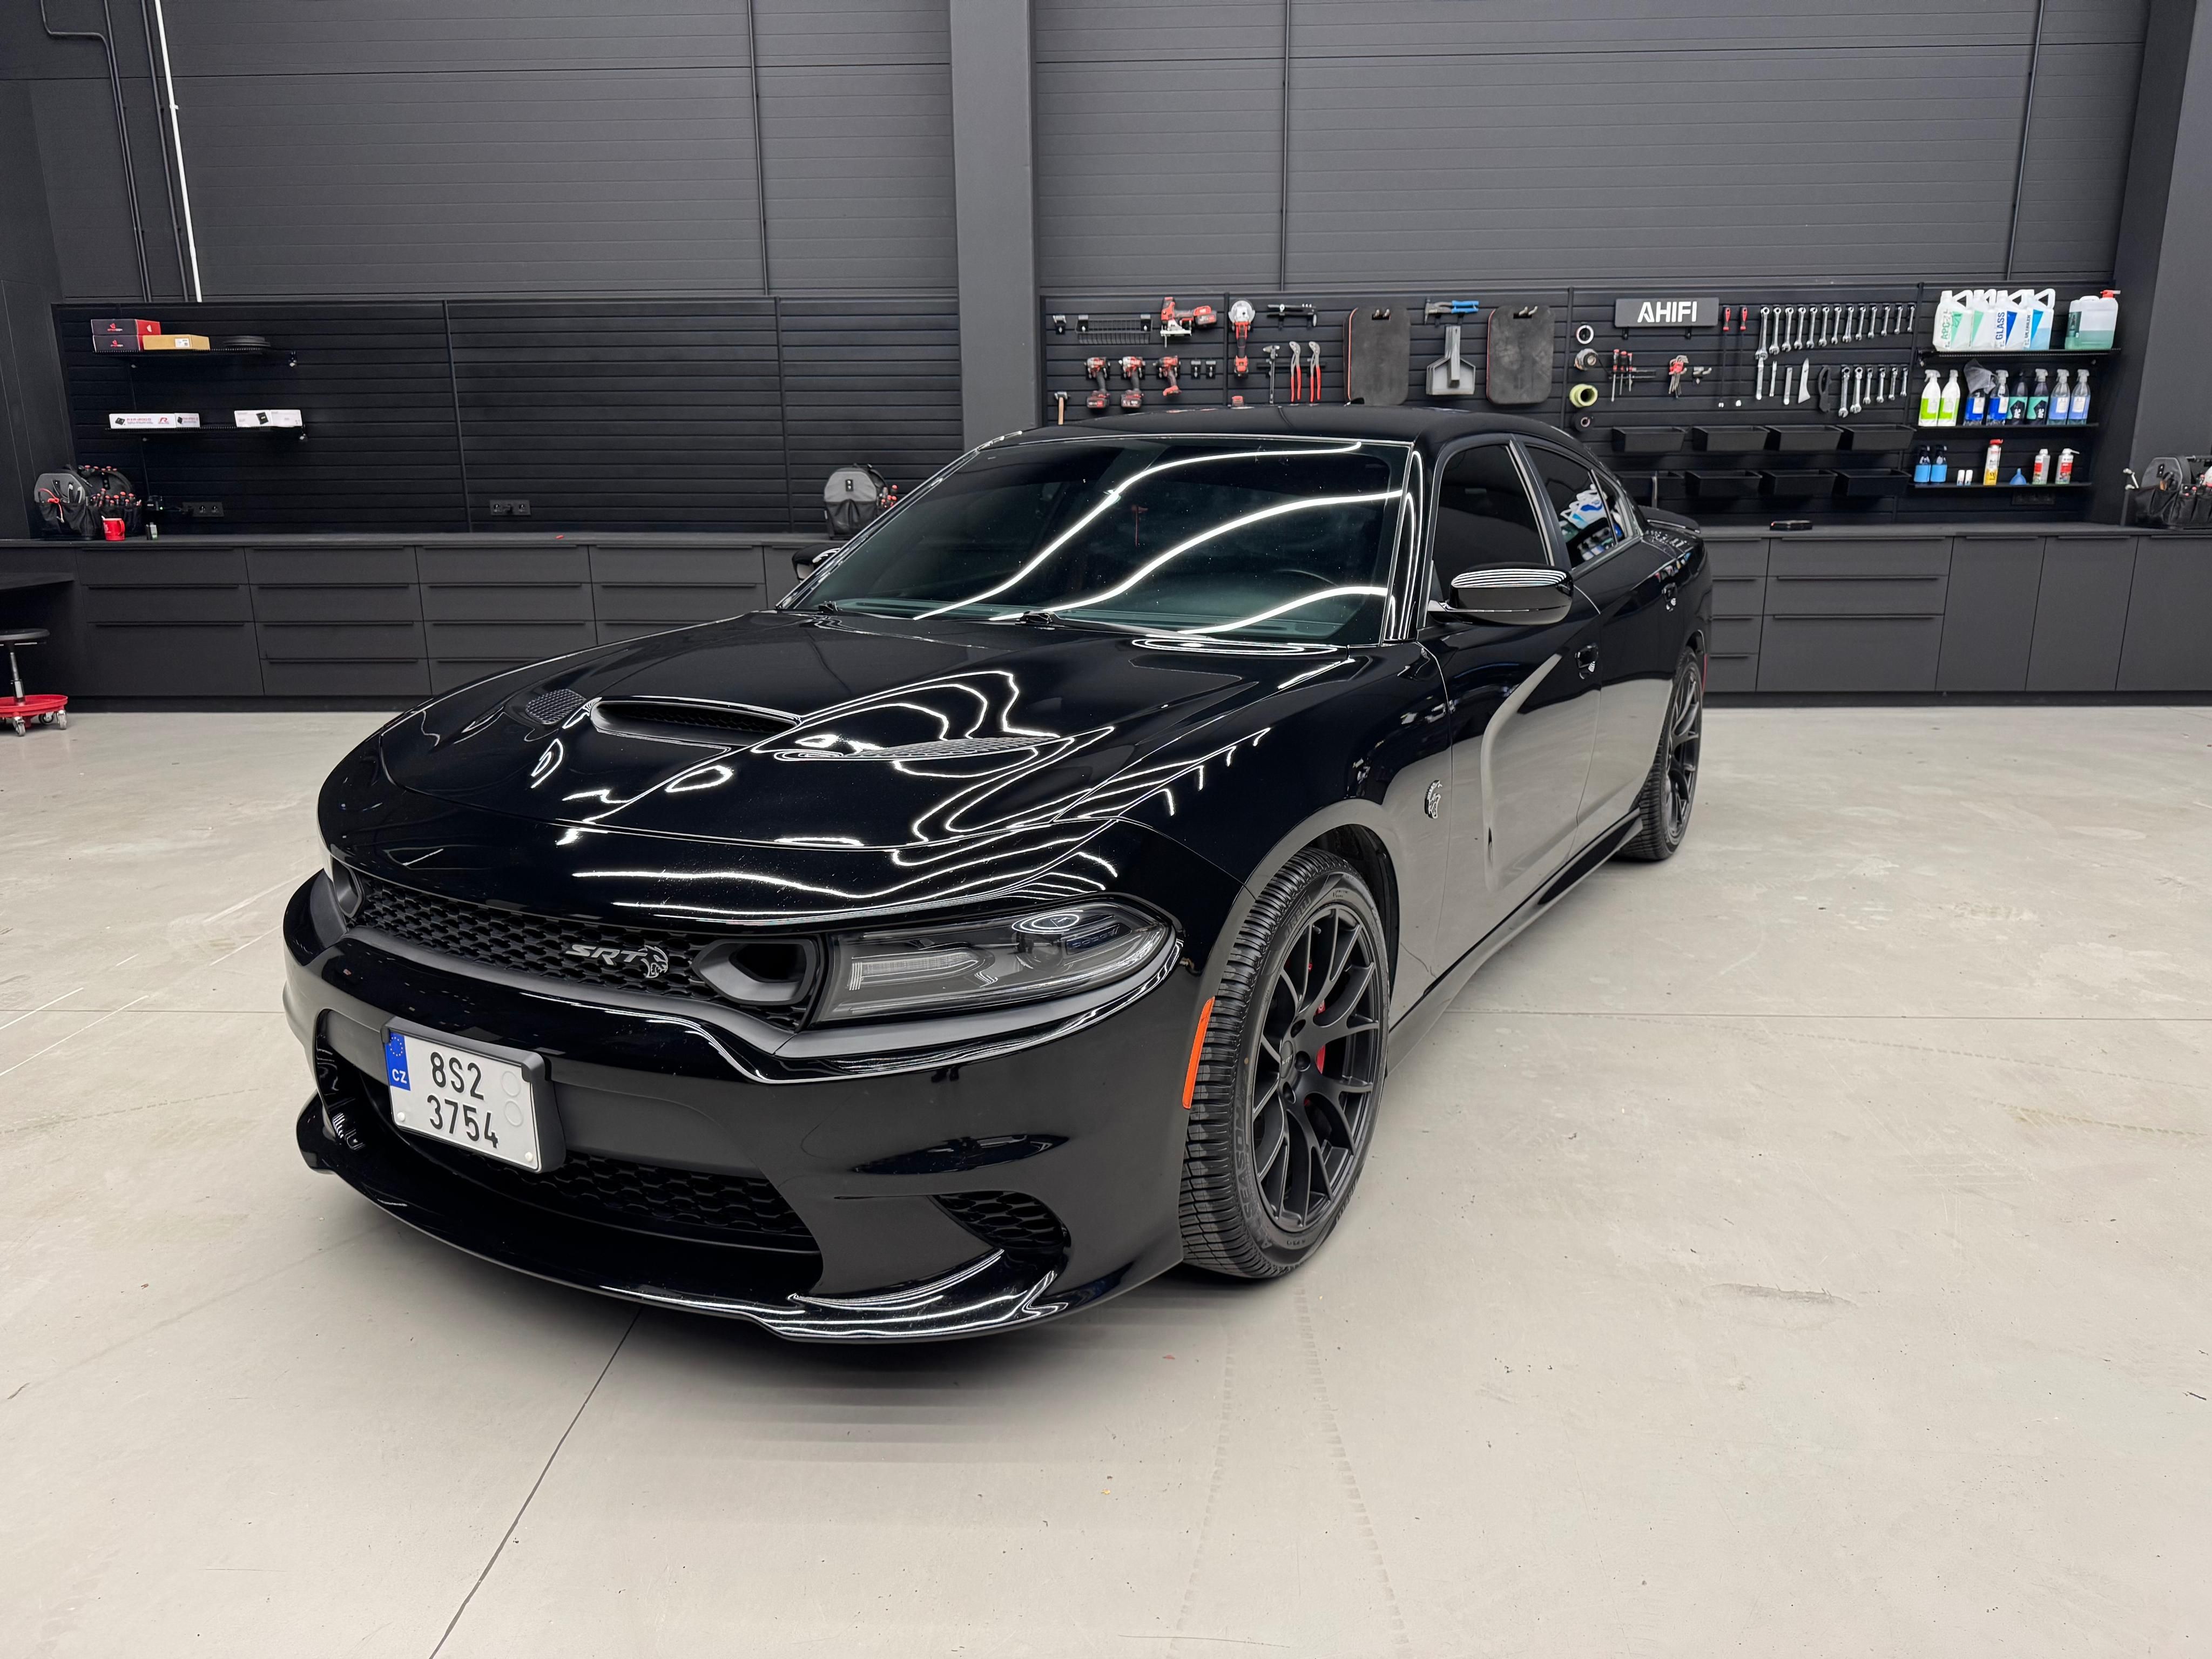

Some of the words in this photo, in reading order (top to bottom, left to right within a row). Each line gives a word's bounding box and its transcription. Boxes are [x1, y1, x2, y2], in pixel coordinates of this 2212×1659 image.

[1637, 301, 1697, 323] AHIFI
[1995, 312, 2005, 340] GLASS
[565, 944, 648, 966] SRT
[392, 1068, 407, 1083] CZ
[430, 1051, 484, 1101] 8S2
[427, 1094, 498, 1149] 3754
[1235, 1107, 1254, 1219] SEASON
